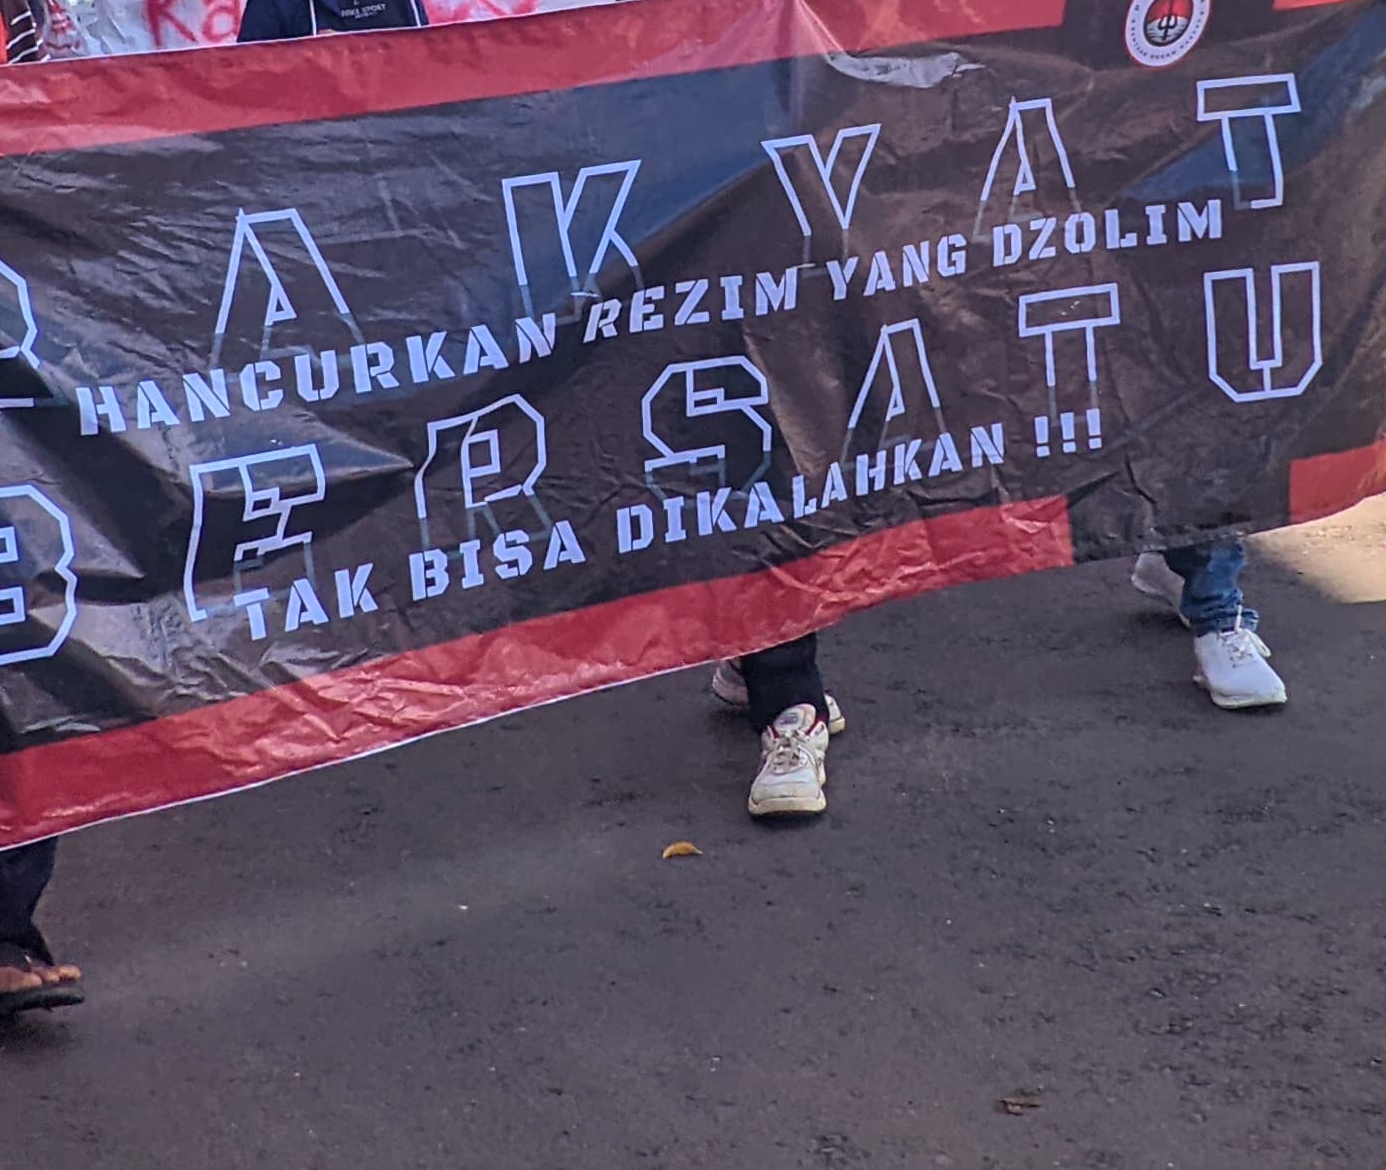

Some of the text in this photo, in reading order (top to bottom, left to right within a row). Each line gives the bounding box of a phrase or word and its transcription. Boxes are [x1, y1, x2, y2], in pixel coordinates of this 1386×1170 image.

[78, 198, 1223, 435] HANCURKAN REZIM YANG DZOLIM
[235, 408, 1103, 641] TAK BISA DIKALAHKAN !!!
